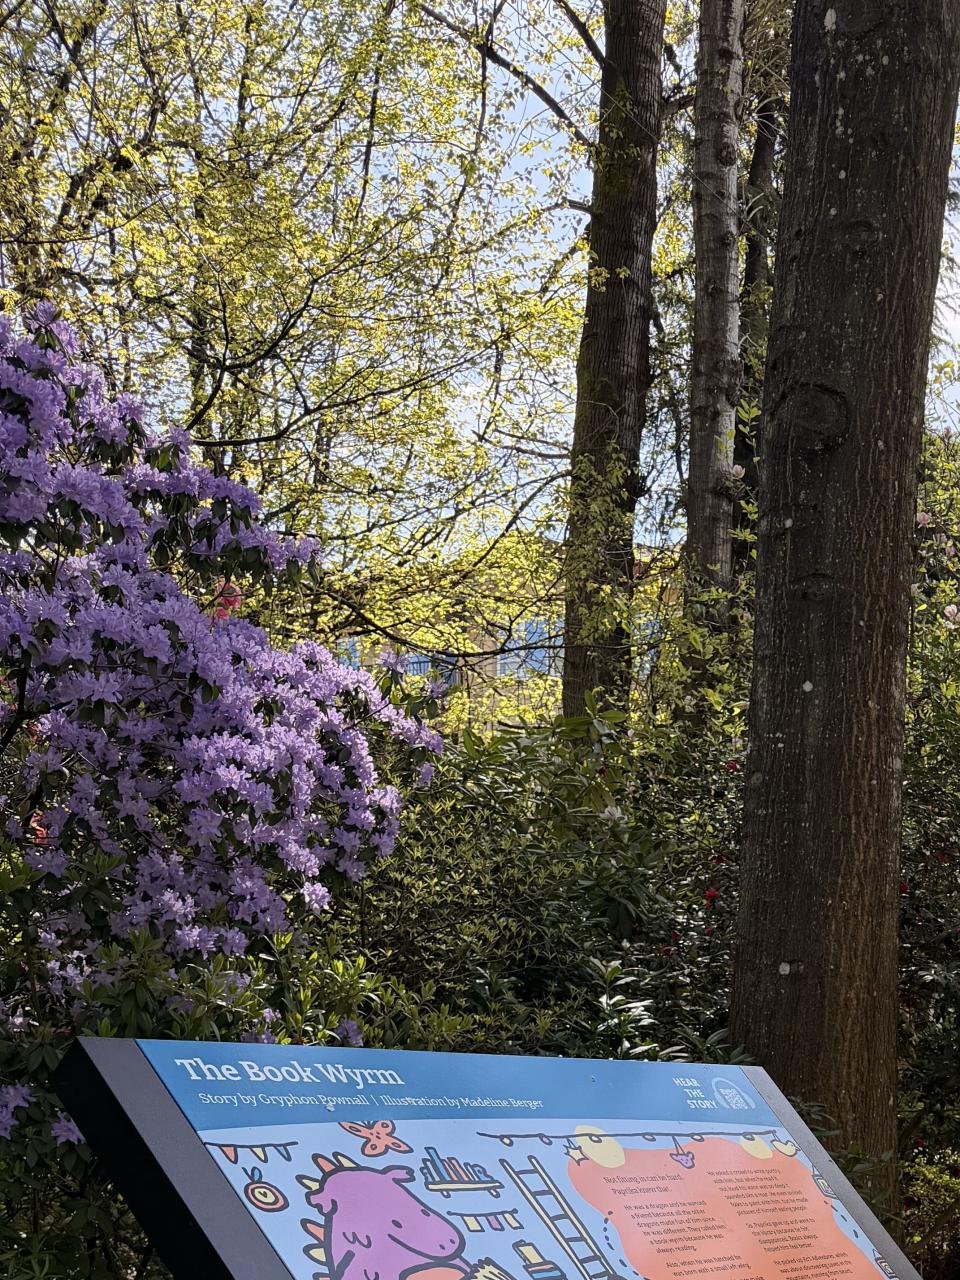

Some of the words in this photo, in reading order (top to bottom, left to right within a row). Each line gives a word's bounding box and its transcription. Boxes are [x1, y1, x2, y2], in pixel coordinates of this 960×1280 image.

[175, 1058, 242, 1080] The
[240, 1061, 320, 1082] Book
[315, 1064, 406, 1089] Wyrm
[672, 1078, 700, 1087] HEAR
[684, 1089, 704, 1098] THE
[199, 1093, 238, 1106] Story
[237, 1093, 256, 1106] by
[259, 1094, 318, 1106] Gryphon
[318, 1095, 369, 1105] Pownall
[380, 1096, 446, 1106] Illustration
[444, 1096, 460, 1108] by
[460, 1097, 509, 1106] Madeline
[509, 1098, 543, 1109] Berger
[686, 1100, 718, 1108] STORY
